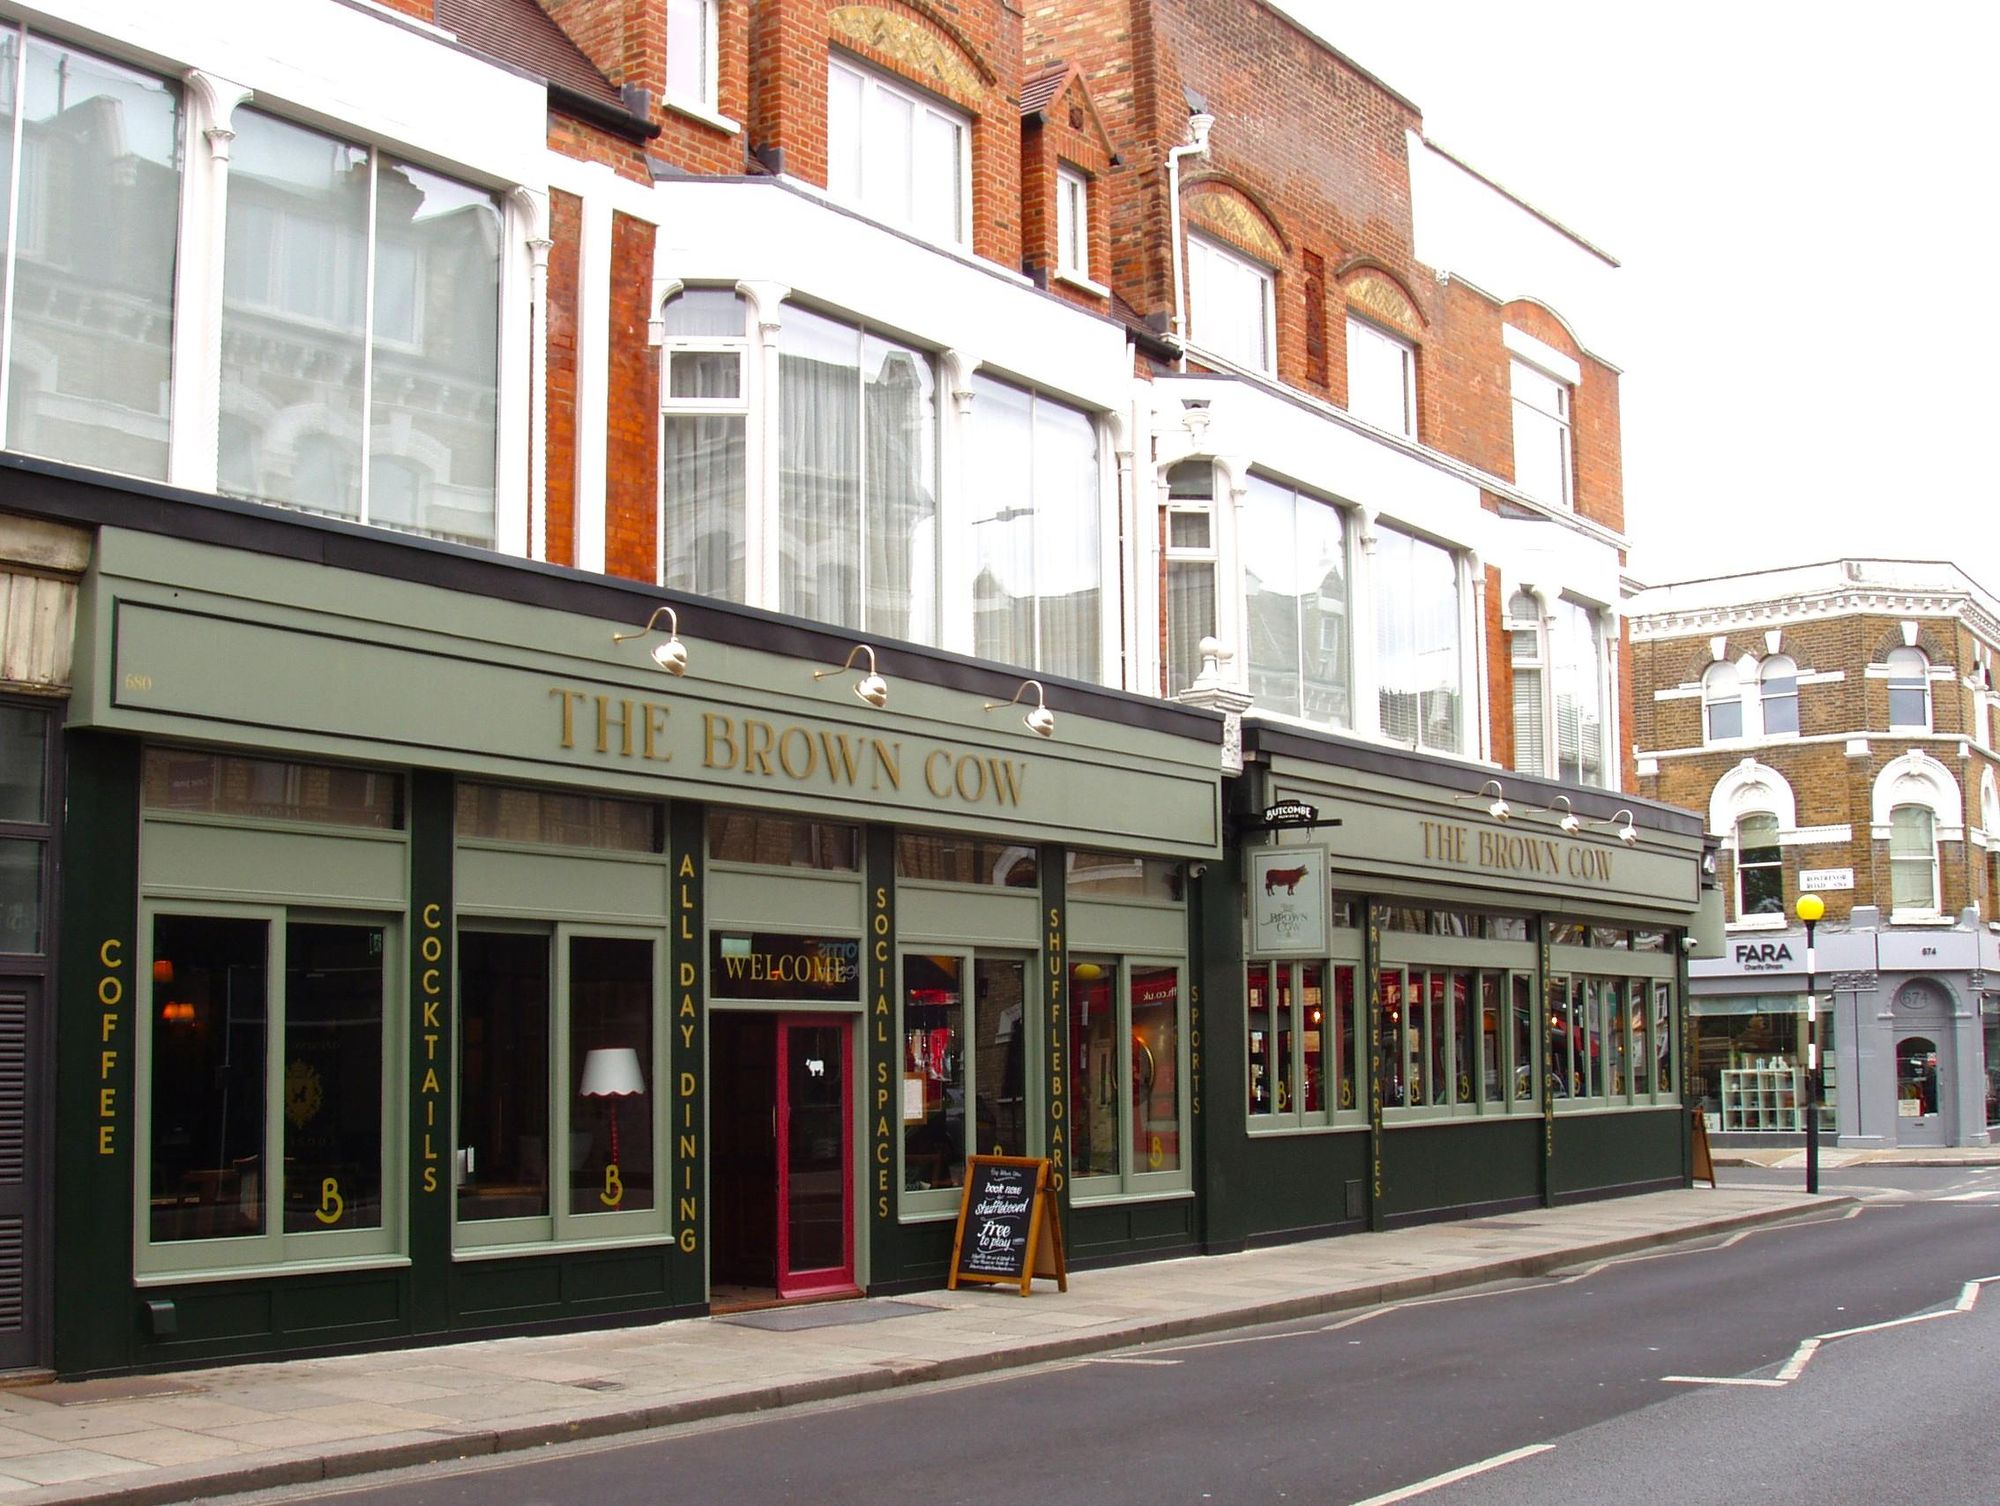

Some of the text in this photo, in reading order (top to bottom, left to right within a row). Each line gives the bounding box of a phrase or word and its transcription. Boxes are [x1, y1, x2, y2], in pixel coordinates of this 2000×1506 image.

[549, 688, 1027, 807] THE BROWN COW
[1265, 805, 1312, 821] BUTCOMBE
[1420, 821, 1614, 882] THE BROWN COW
[721, 953, 847, 984] WELCOME
[1735, 943, 1793, 963] FARA
[98, 938, 123, 1155] COFFEE
[421, 903, 441, 1193] COCKTAILS
[679, 854, 696, 1254] ALL DAY DINING
[874, 887, 889, 1219] SOCIAL SPACES
[1048, 908, 1064, 1192] SHUFFLEBOARD
[1191, 985, 1201, 1115] SPORTS
[1371, 905, 1381, 1198] PRIVATE PARTIES
[977, 1220, 1012, 1238] free
[979, 1235, 990, 1247] to
[988, 1237, 1012, 1251] play
[984, 1182, 1003, 1194] book
